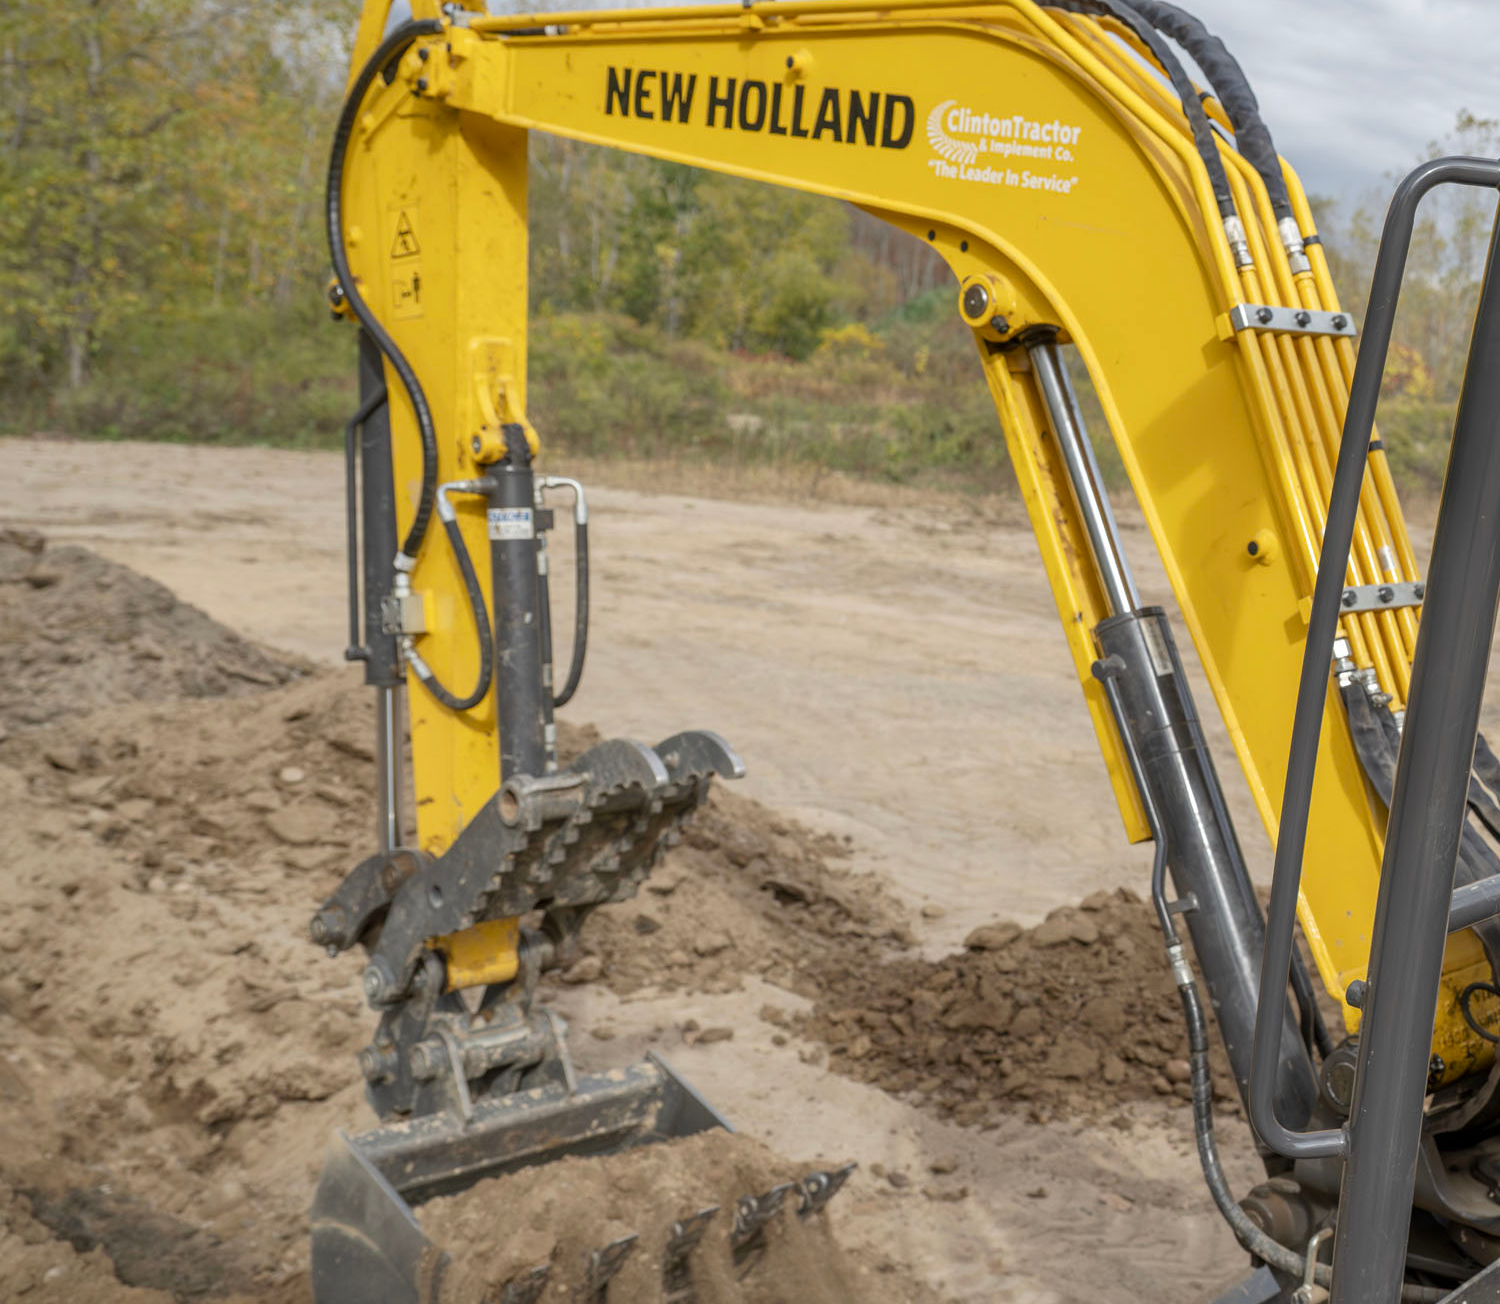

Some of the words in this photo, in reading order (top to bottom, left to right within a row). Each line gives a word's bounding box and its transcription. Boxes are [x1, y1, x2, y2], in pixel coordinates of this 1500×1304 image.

[605, 66, 697, 124] NEW
[706, 76, 915, 150] HOLLAND
[947, 107, 1081, 145] ClintonTractor
[978, 137, 987, 152] &
[989, 139, 1053, 158] Implement
[1054, 146, 1074, 162] Co.
[959, 164, 1004, 184] Leader
[1005, 168, 1019, 186] In
